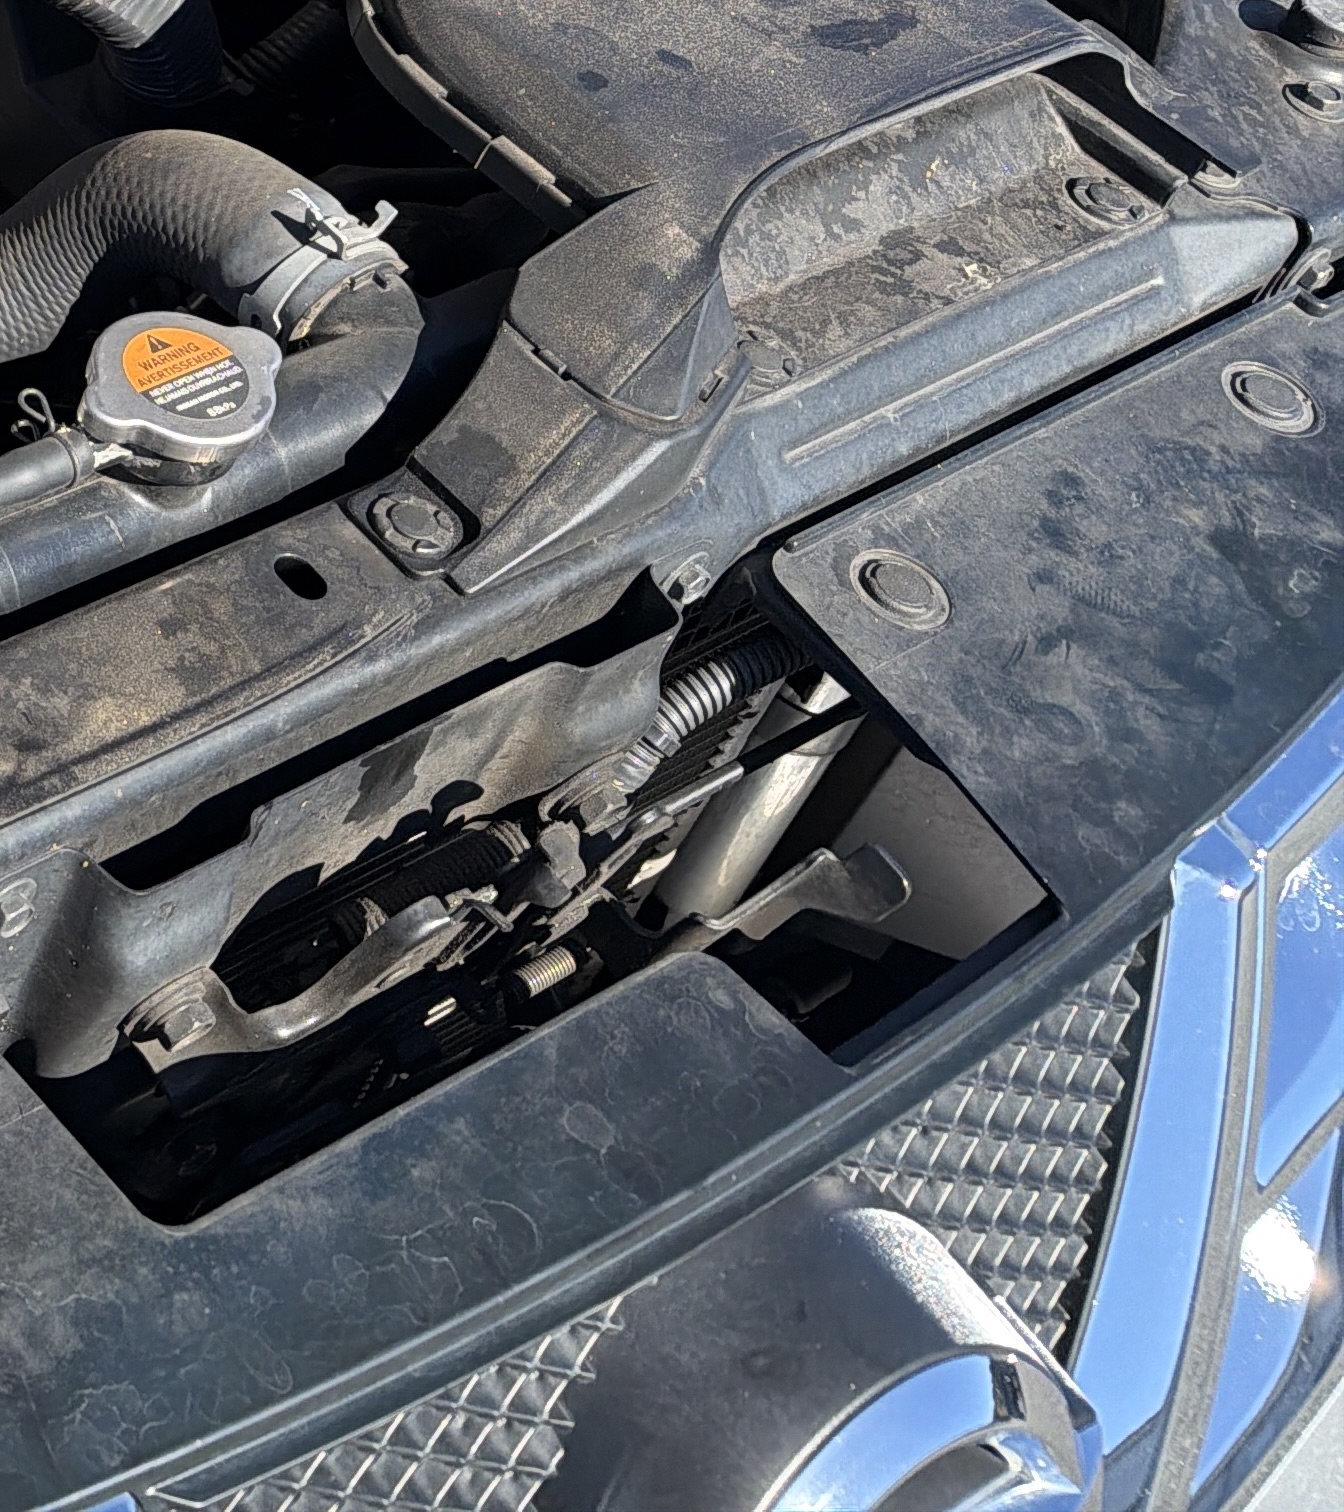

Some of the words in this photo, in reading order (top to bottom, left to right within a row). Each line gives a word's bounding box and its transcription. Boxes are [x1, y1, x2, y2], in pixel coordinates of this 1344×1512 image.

[137, 341, 201, 371] WARNING
[137, 347, 224, 388] AVERTISSEMENT
[148, 382, 174, 397] NEVER
[172, 373, 195, 387] OPEN
